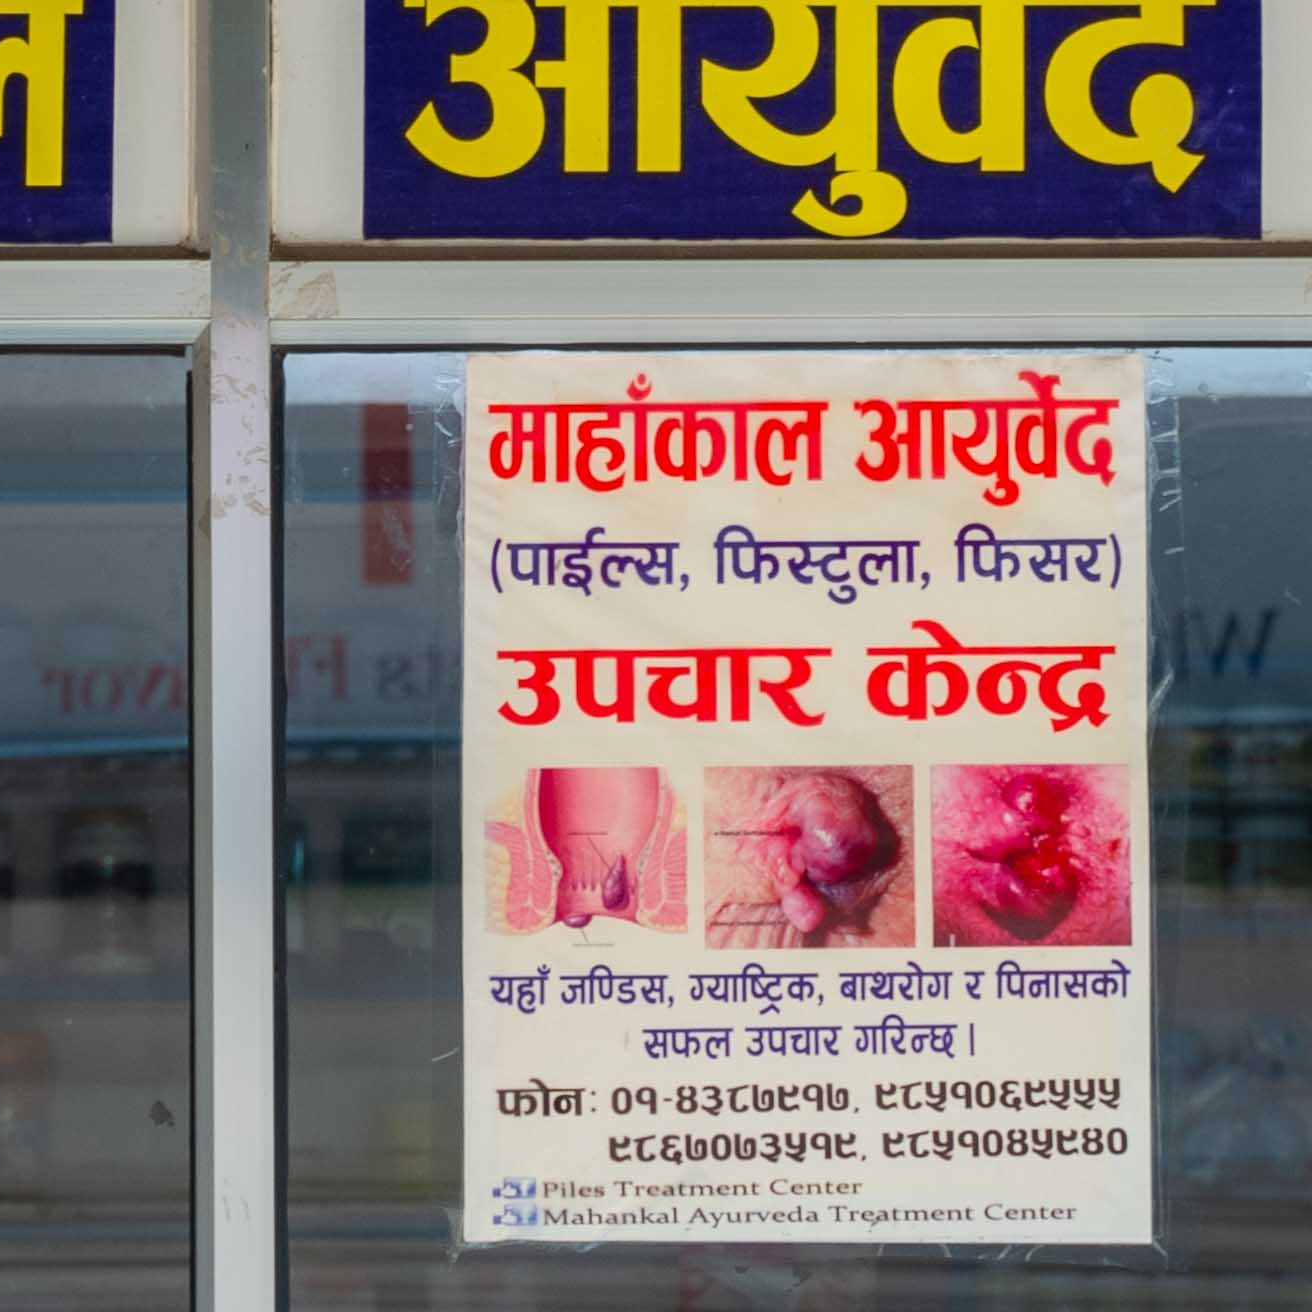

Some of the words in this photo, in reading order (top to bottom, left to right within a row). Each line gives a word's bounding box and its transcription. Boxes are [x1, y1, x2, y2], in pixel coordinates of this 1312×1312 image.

[487, 373, 828, 493] माहाँकाल
[854, 370, 1120, 508] आयुर्वेद
[491, 526, 690, 596] (पाईल्स,
[714, 524, 931, 605] फिस्टुला,
[954, 523, 1124, 589] फिसर)
[497, 647, 832, 727] उपचार
[865, 619, 1117, 733] केन्द्र
[489, 963, 551, 1015] यहाँ
[559, 964, 675, 1009] जण्डिस,
[689, 962, 825, 1015] ग्याष्ट्रिक,
[839, 960, 953, 1001] बाथरोग
[964, 971, 985, 1001] र
[996, 958, 1132, 999] पिनासको
[642, 1027, 734, 1060] सफल
[744, 1026, 843, 1058] उपचार
[853, 1014, 958, 1059] गरिन्छ
[611, 1082, 860, 1117] ०१-४३८७९१७,
[875, 1077, 1121, 1113] ९८५१०६९५५५
[608, 1131, 868, 1166] ९८६७०७३५१९,
[882, 1128, 1129, 1161] ९८५१०४५९४०
[541, 1181, 606, 1199] Piles
[613, 1180, 764, 1198] Treatment
[768, 1177, 863, 1197] Center
[542, 1205, 681, 1226] Mahankal
[688, 1205, 820, 1227] Ayurveda
[830, 1203, 976, 1224] Treatment
[983, 1200, 1077, 1222] Center
